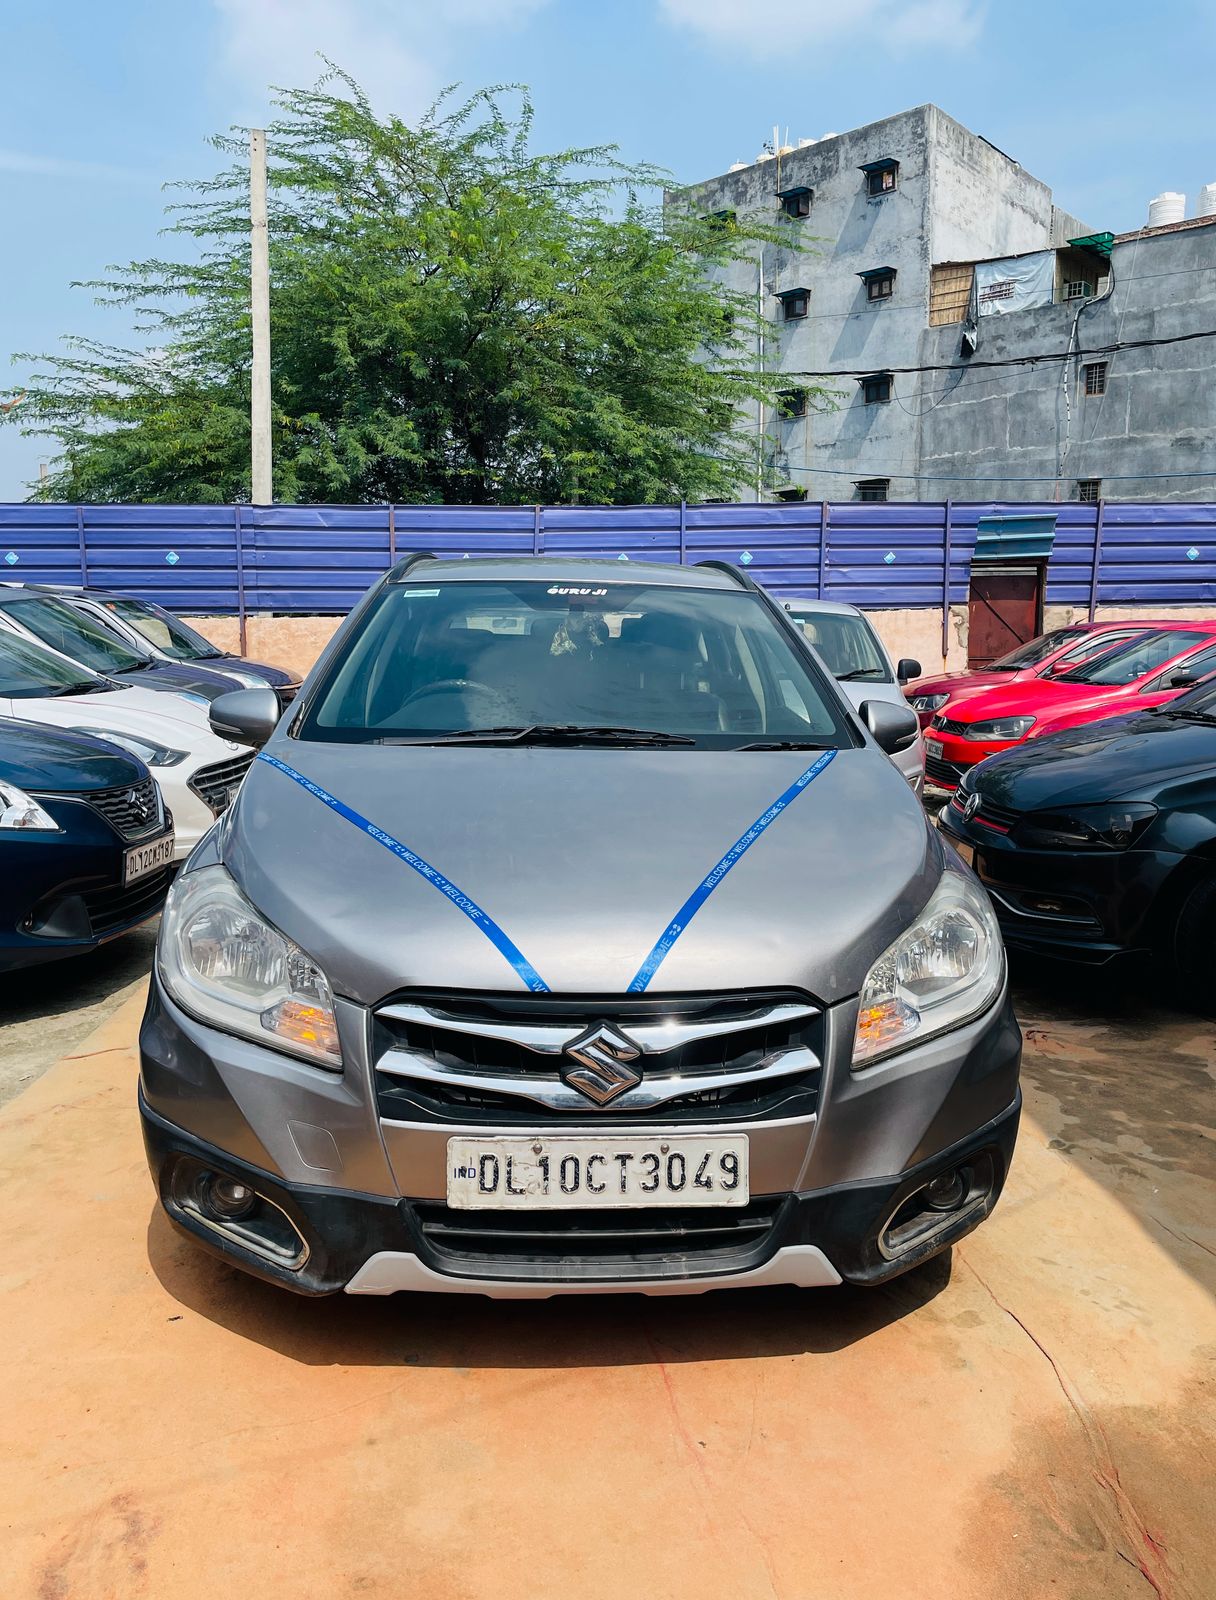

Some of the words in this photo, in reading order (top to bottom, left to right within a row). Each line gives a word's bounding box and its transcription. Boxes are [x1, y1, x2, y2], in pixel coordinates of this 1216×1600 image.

[547, 586, 591, 595] GURU
[592, 588, 608, 596] JI
[401, 851, 437, 878] WELCOME
[442, 884, 482, 919] WELCOME
[703, 858, 732, 889] WELCOME
[734, 830, 758, 853] WELCOME
[479, 1150, 740, 1195] DL10CT3049
